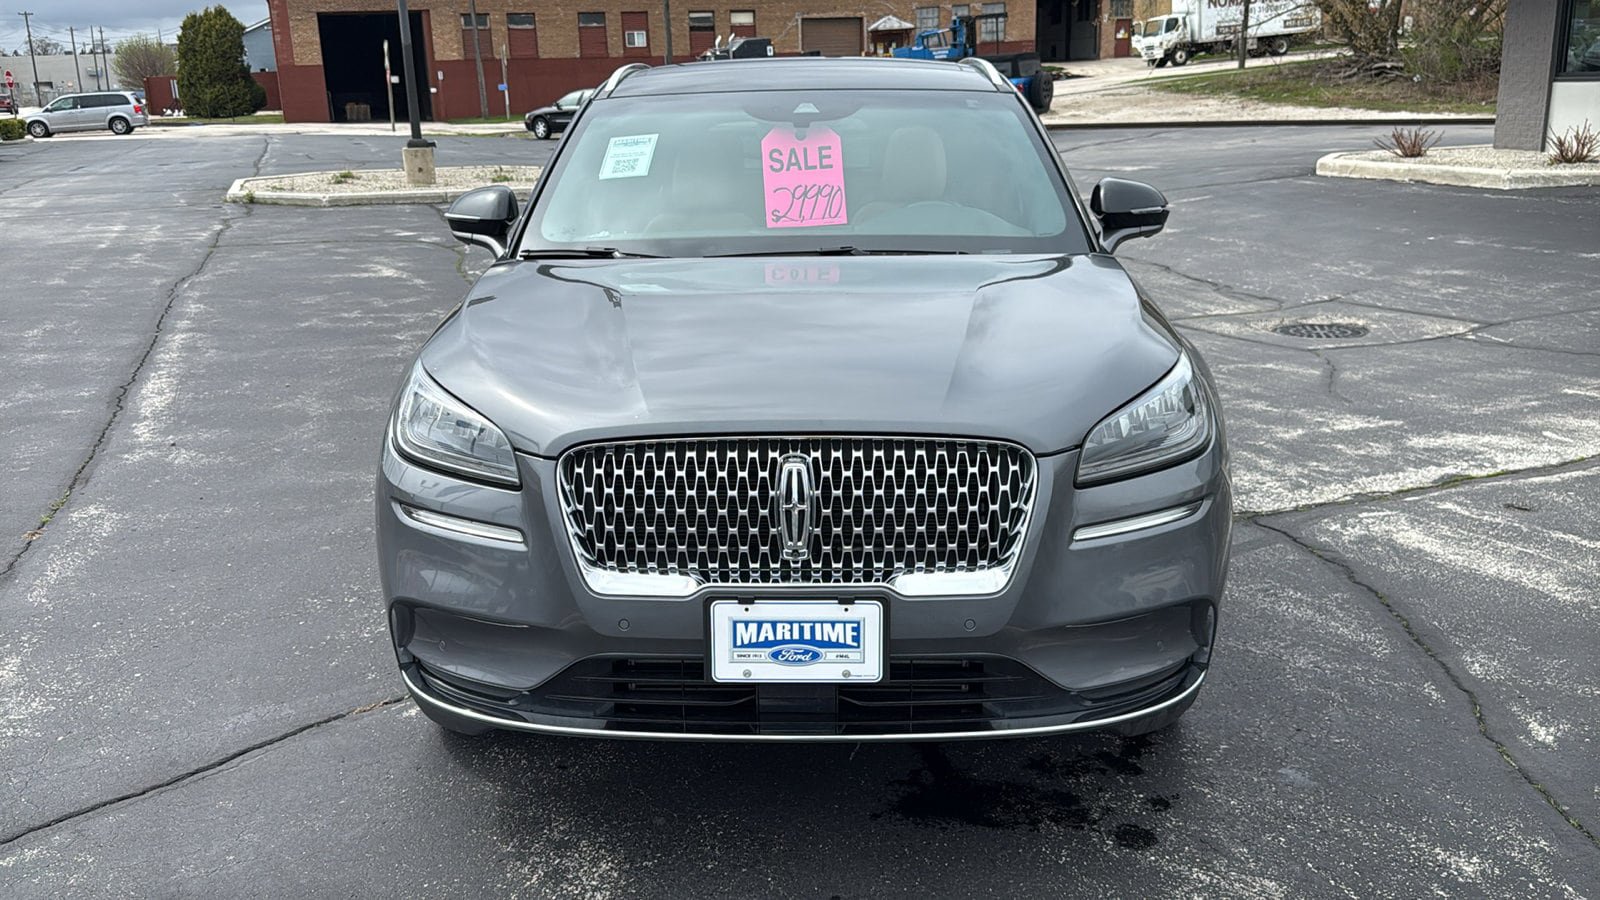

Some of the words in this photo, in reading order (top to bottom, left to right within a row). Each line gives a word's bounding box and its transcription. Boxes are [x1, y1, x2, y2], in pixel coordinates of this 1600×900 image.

[1207, 0, 1257, 9] NOMA
[769, 145, 833, 173] SALE
[735, 622, 858, 647] MARITIME
[778, 648, 813, 662] Ford
